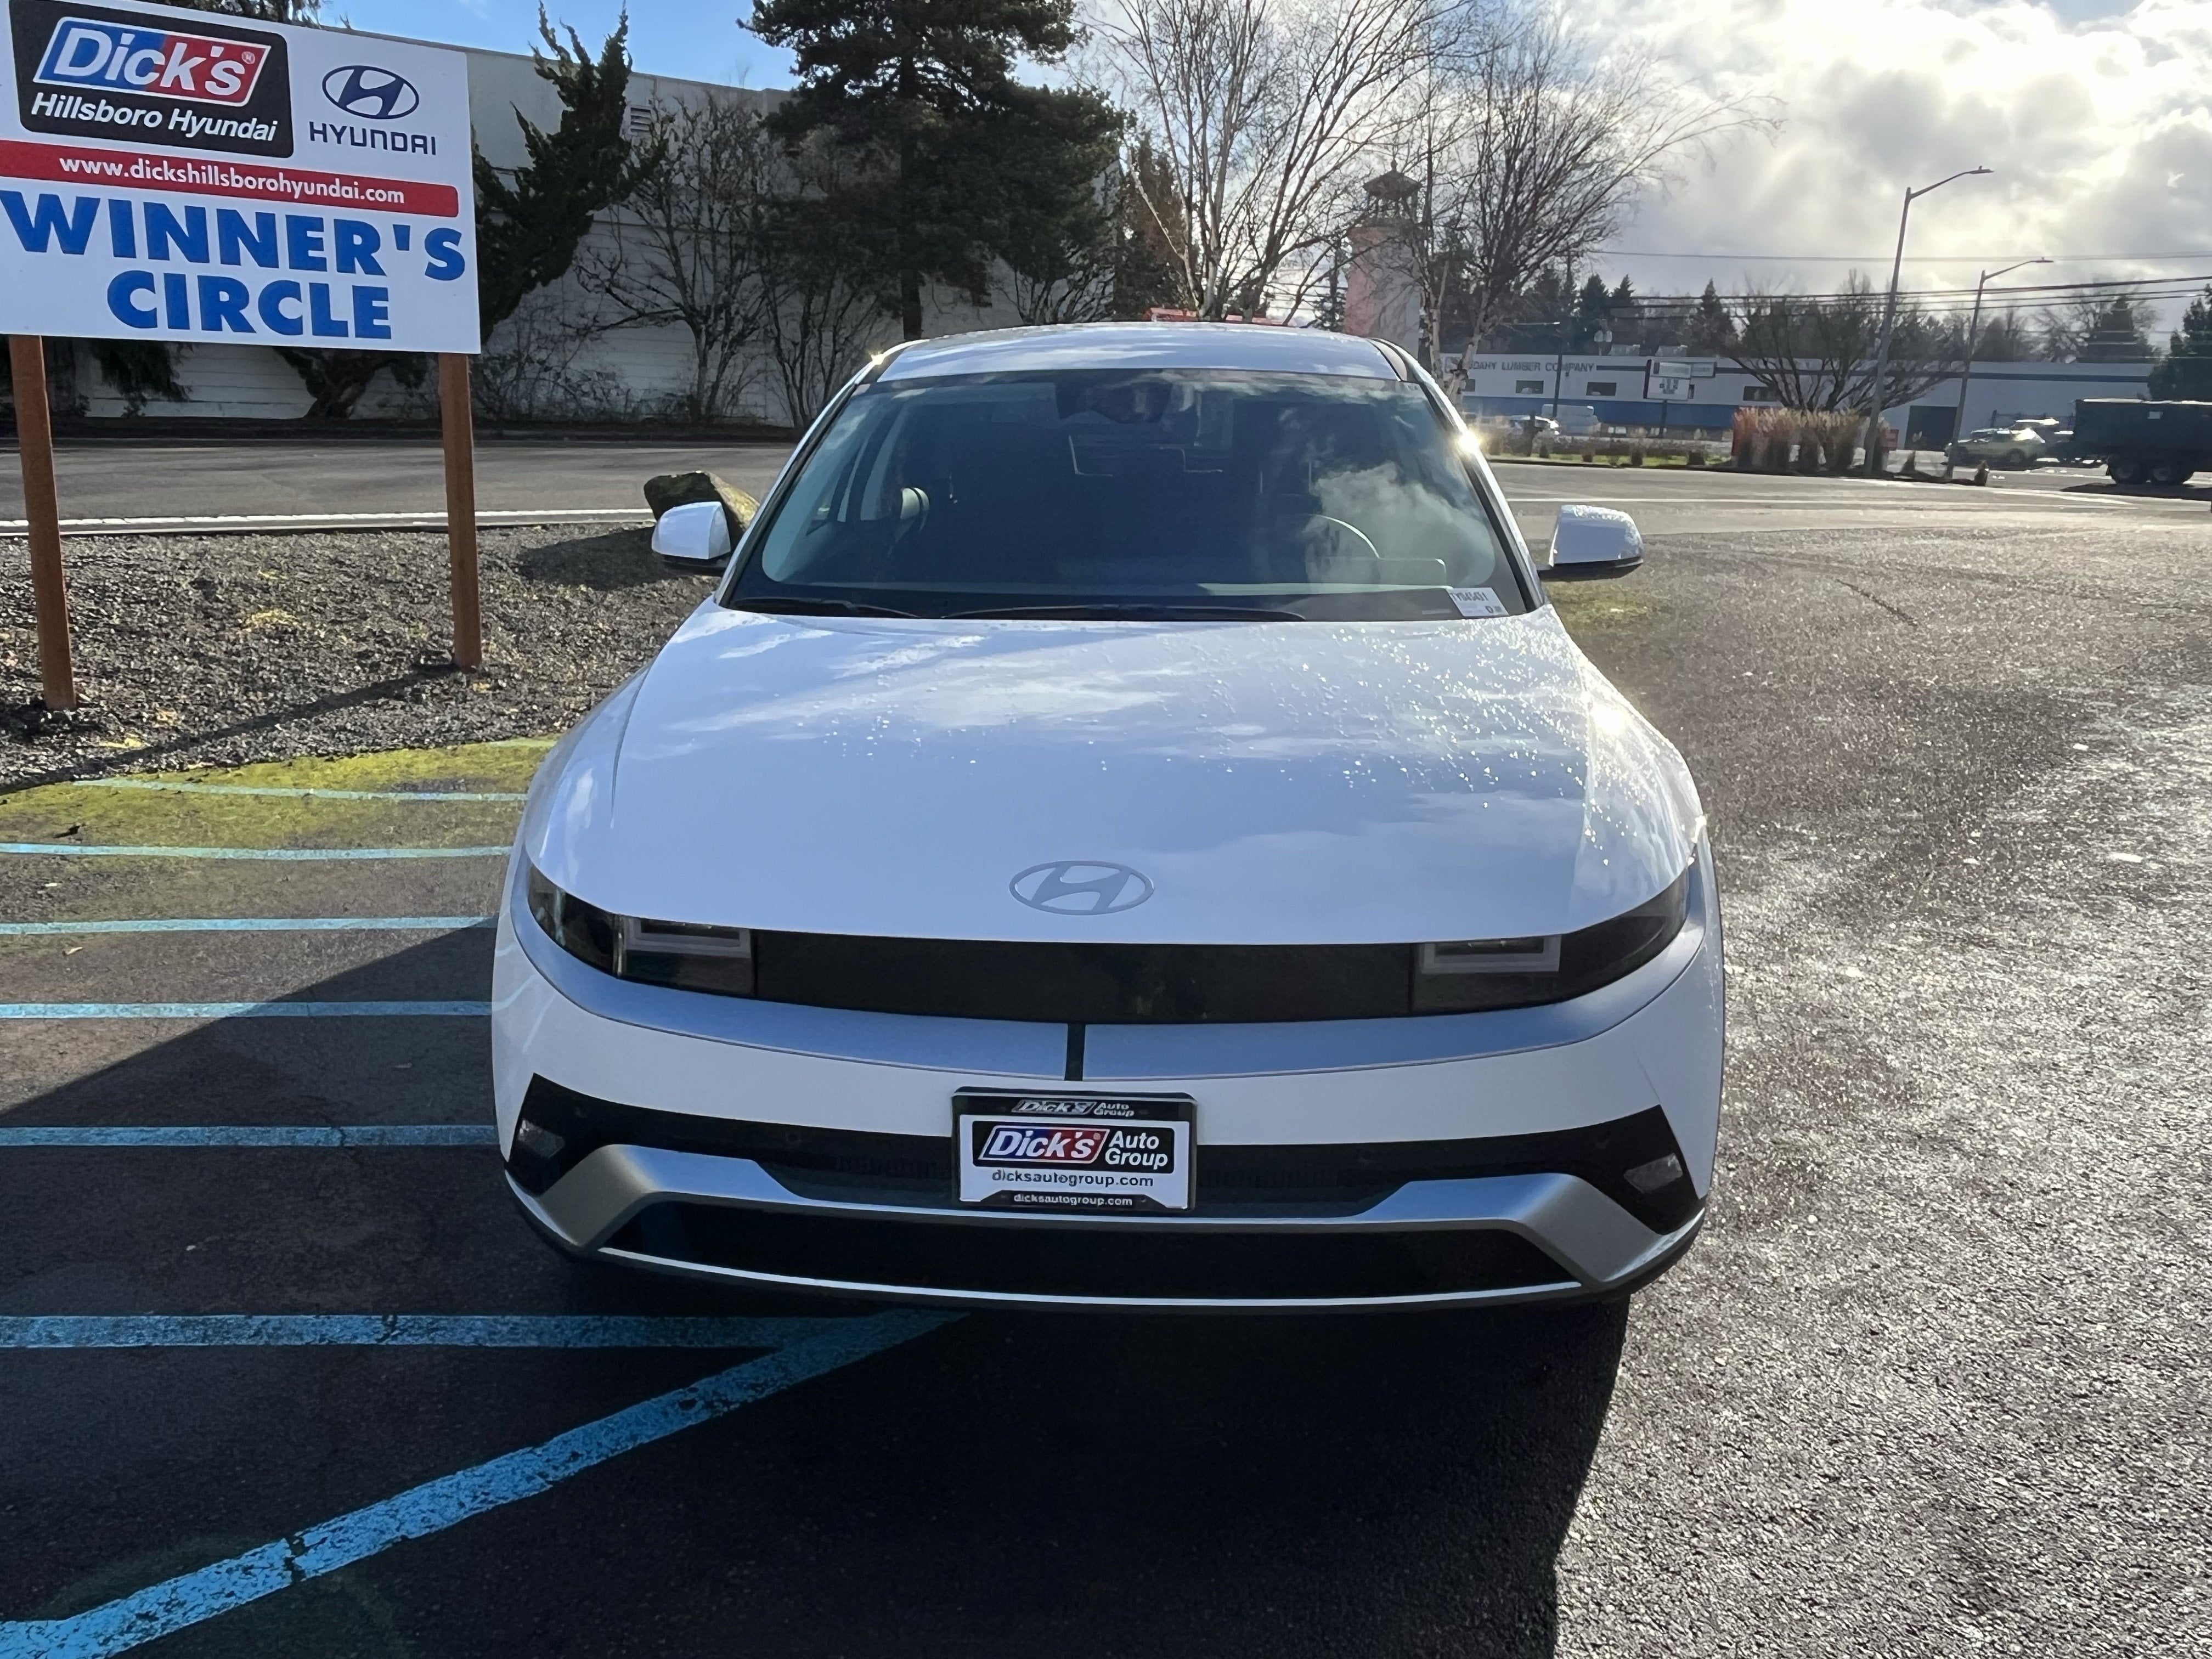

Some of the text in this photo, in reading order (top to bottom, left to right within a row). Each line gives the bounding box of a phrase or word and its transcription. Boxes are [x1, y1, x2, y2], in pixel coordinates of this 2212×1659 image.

[54, 28, 245, 95] Dick's
[31, 92, 278, 141] Hillsboro Hyundai
[310, 122, 436, 155] HYUNDAI
[59, 155, 405, 204] www.dickshillsborohyundai.com
[0, 190, 466, 280] WINNER'S
[107, 270, 392, 340] CIRCLE
[989, 1130, 1159, 1159] Dick's Auto
[1105, 1149, 1168, 1170] Group
[992, 1169, 1153, 1187] dicksautogroup.com
[1013, 1193, 1133, 1206] dicksautogroup.com
